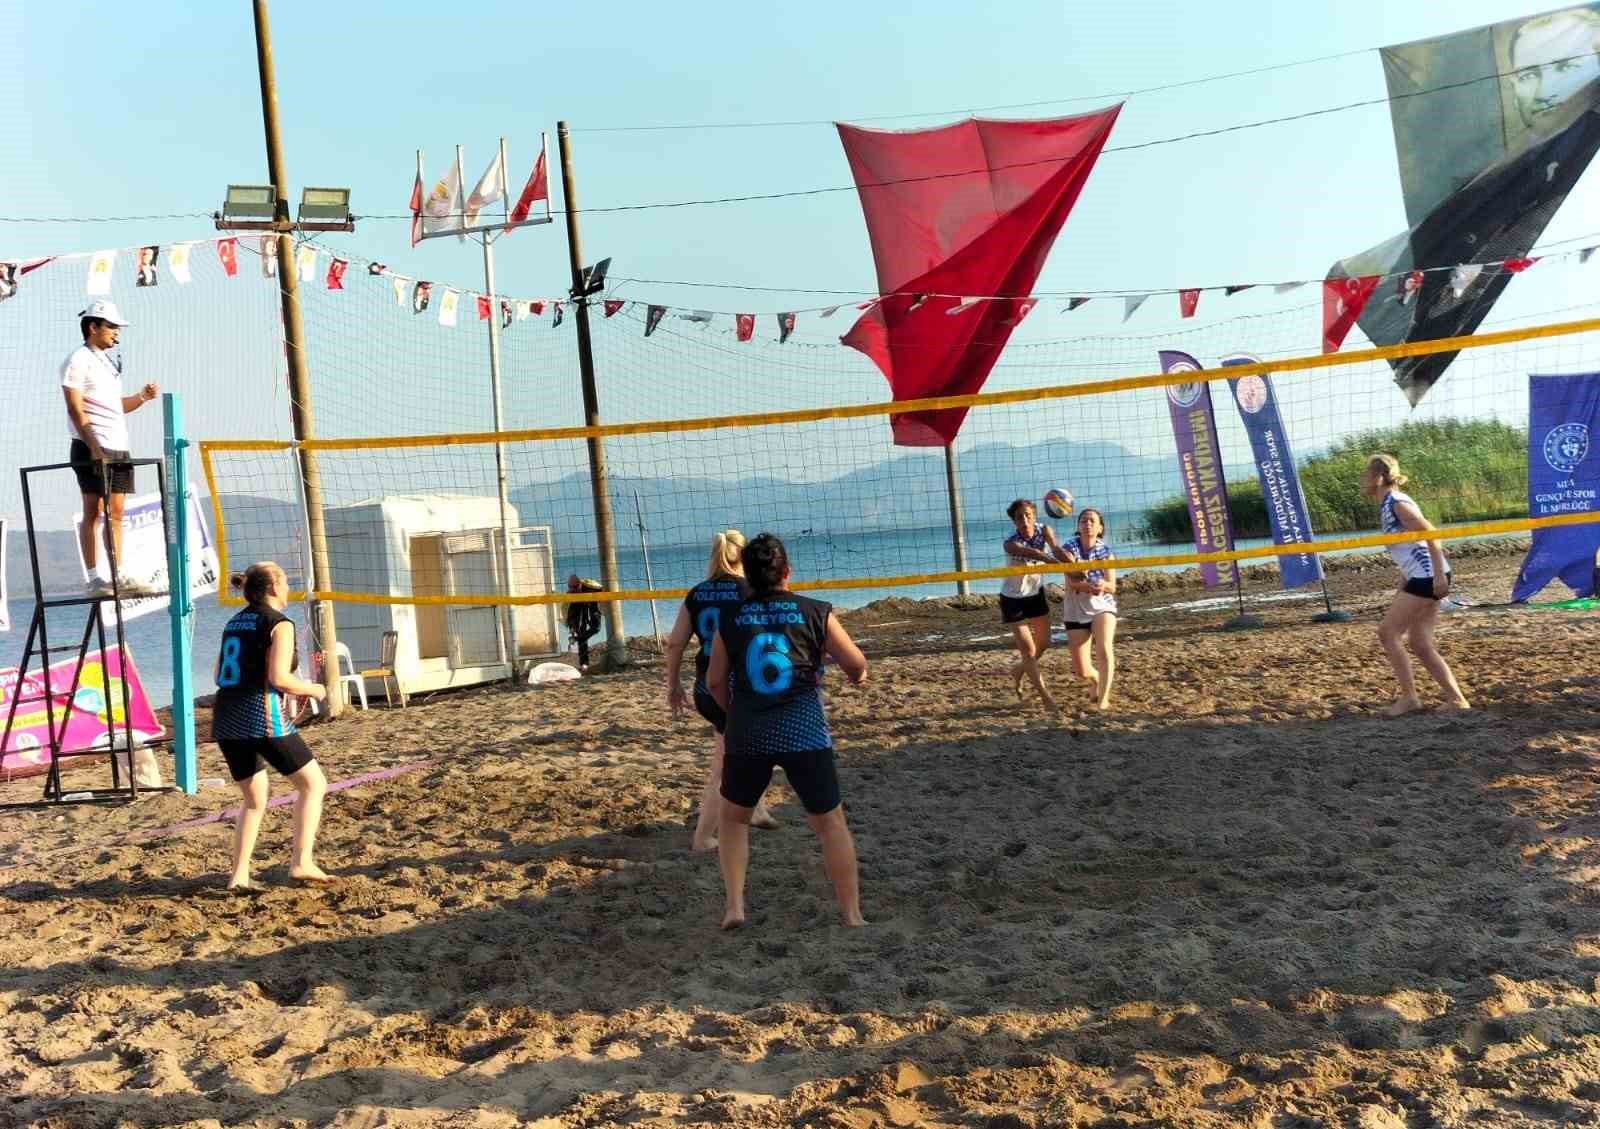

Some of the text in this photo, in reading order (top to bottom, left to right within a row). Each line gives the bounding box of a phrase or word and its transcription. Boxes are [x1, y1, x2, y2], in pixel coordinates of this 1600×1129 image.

[735, 612, 806, 627] VOLEYBOL
[768, 601, 798, 611] SPOR
[219, 636, 241, 688] 8
[746, 632, 793, 695] 6
